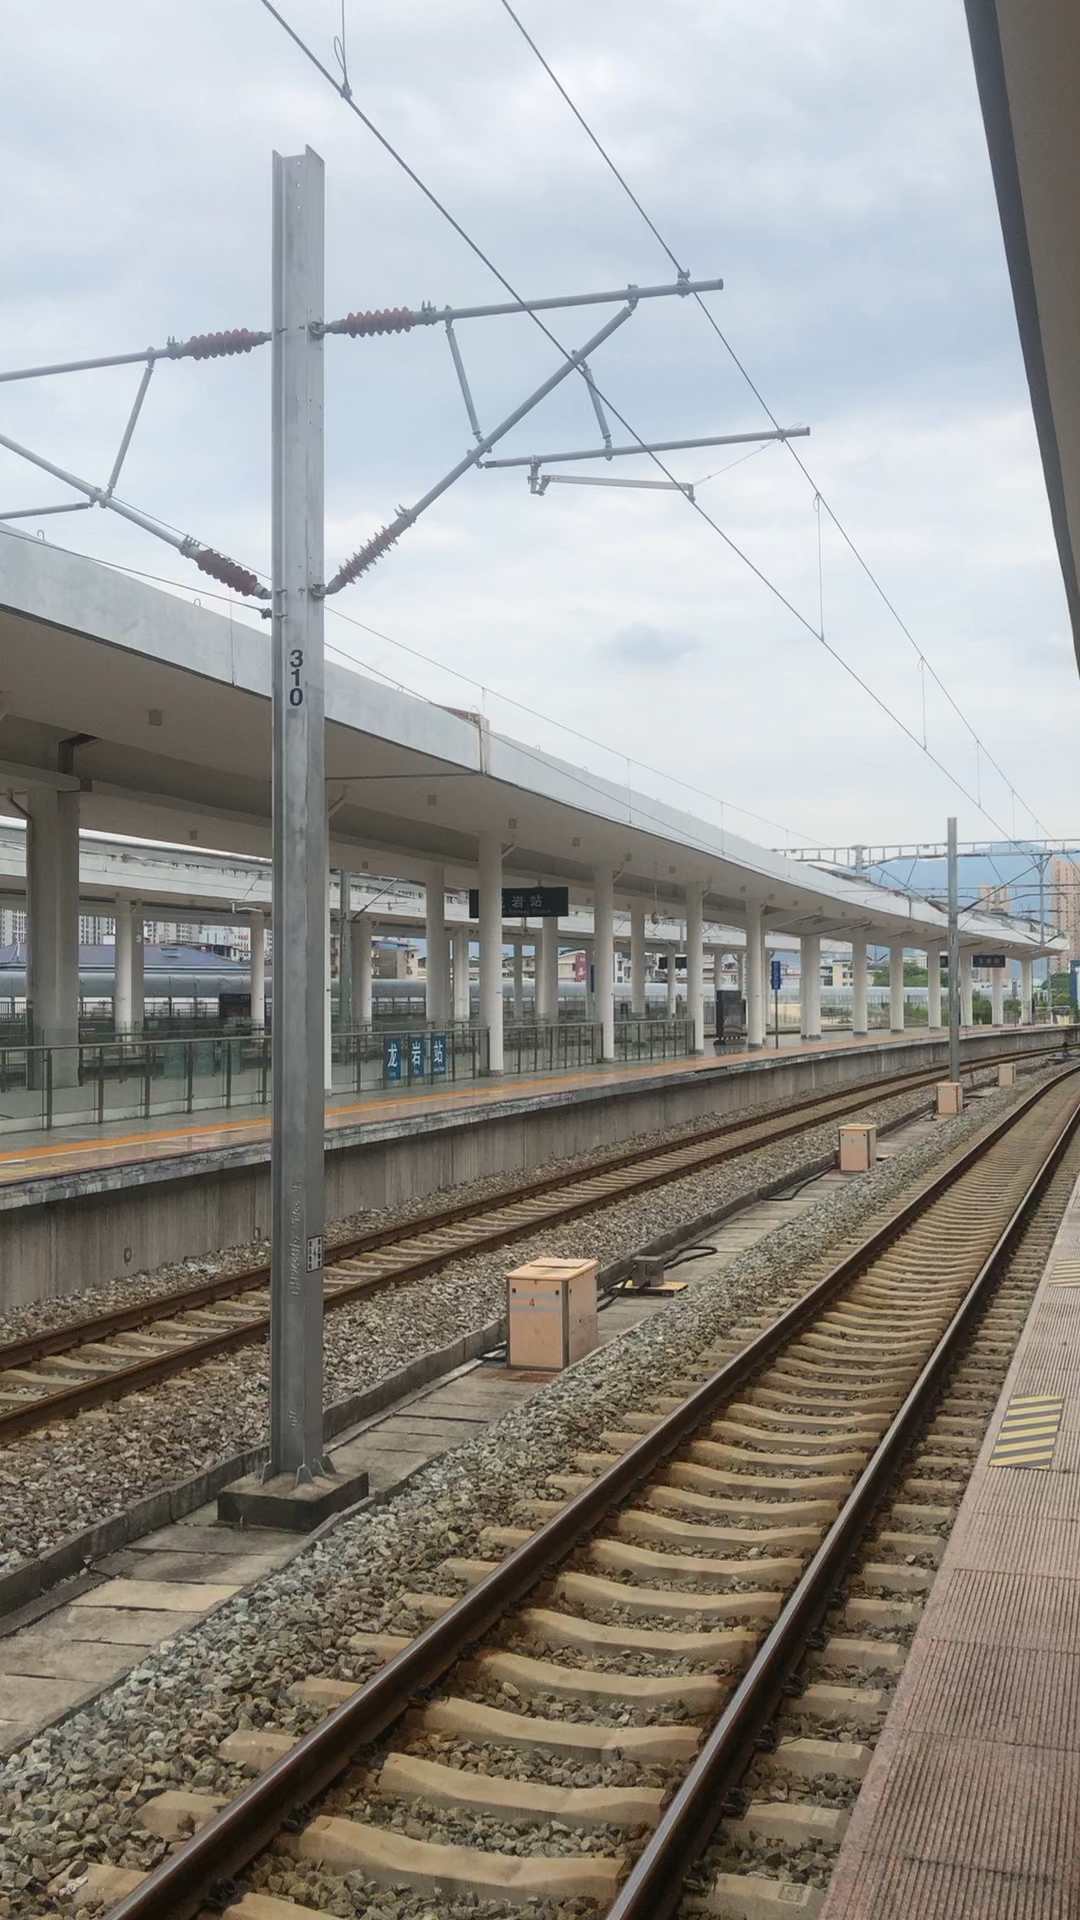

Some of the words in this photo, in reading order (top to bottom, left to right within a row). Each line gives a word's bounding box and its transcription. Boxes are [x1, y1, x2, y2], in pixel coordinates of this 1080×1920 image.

[289, 649, 304, 707] 310
[501, 894, 543, 909] 岩站
[387, 1040, 444, 1068] 龙岩站
